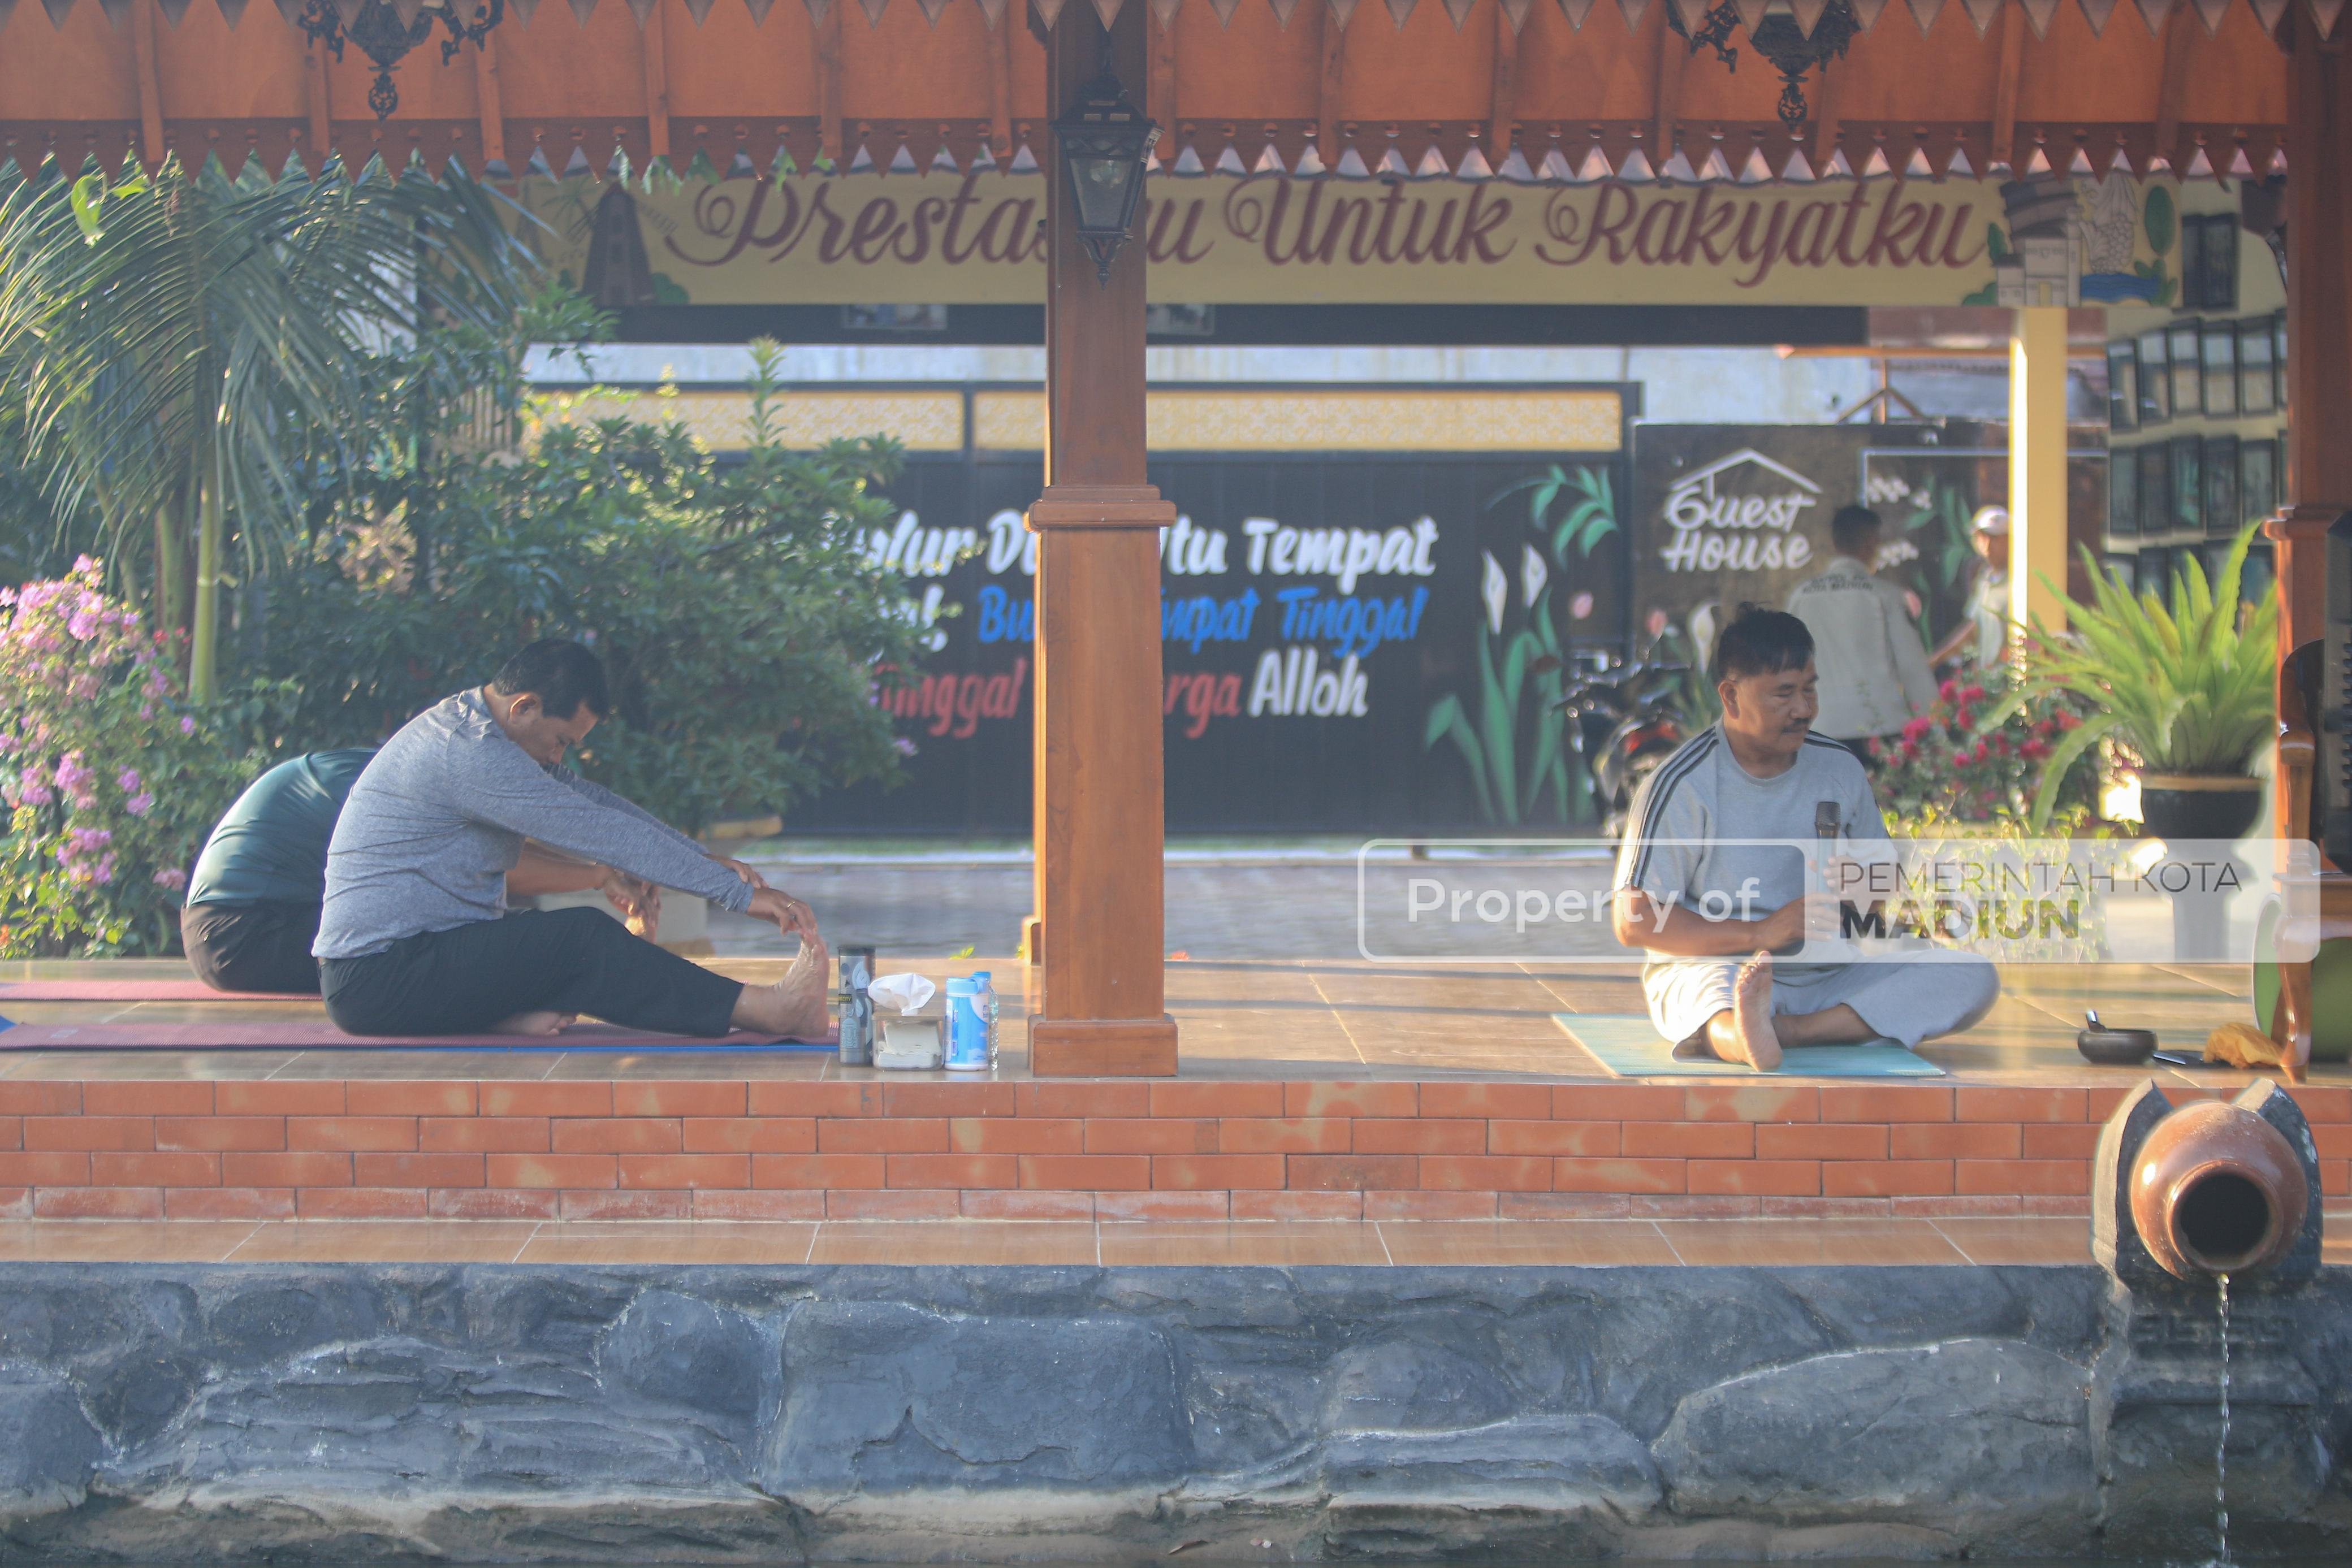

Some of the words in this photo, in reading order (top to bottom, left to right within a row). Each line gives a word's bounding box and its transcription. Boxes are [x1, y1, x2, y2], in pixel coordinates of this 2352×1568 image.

[1223, 173, 1518, 265] Untuk
[1534, 180, 1987, 288] Rakyatku
[1663, 483, 1817, 532] Guest
[1242, 516, 1439, 595] Tempat
[1660, 530, 1813, 572] House
[1276, 584, 1430, 659] Tinggal
